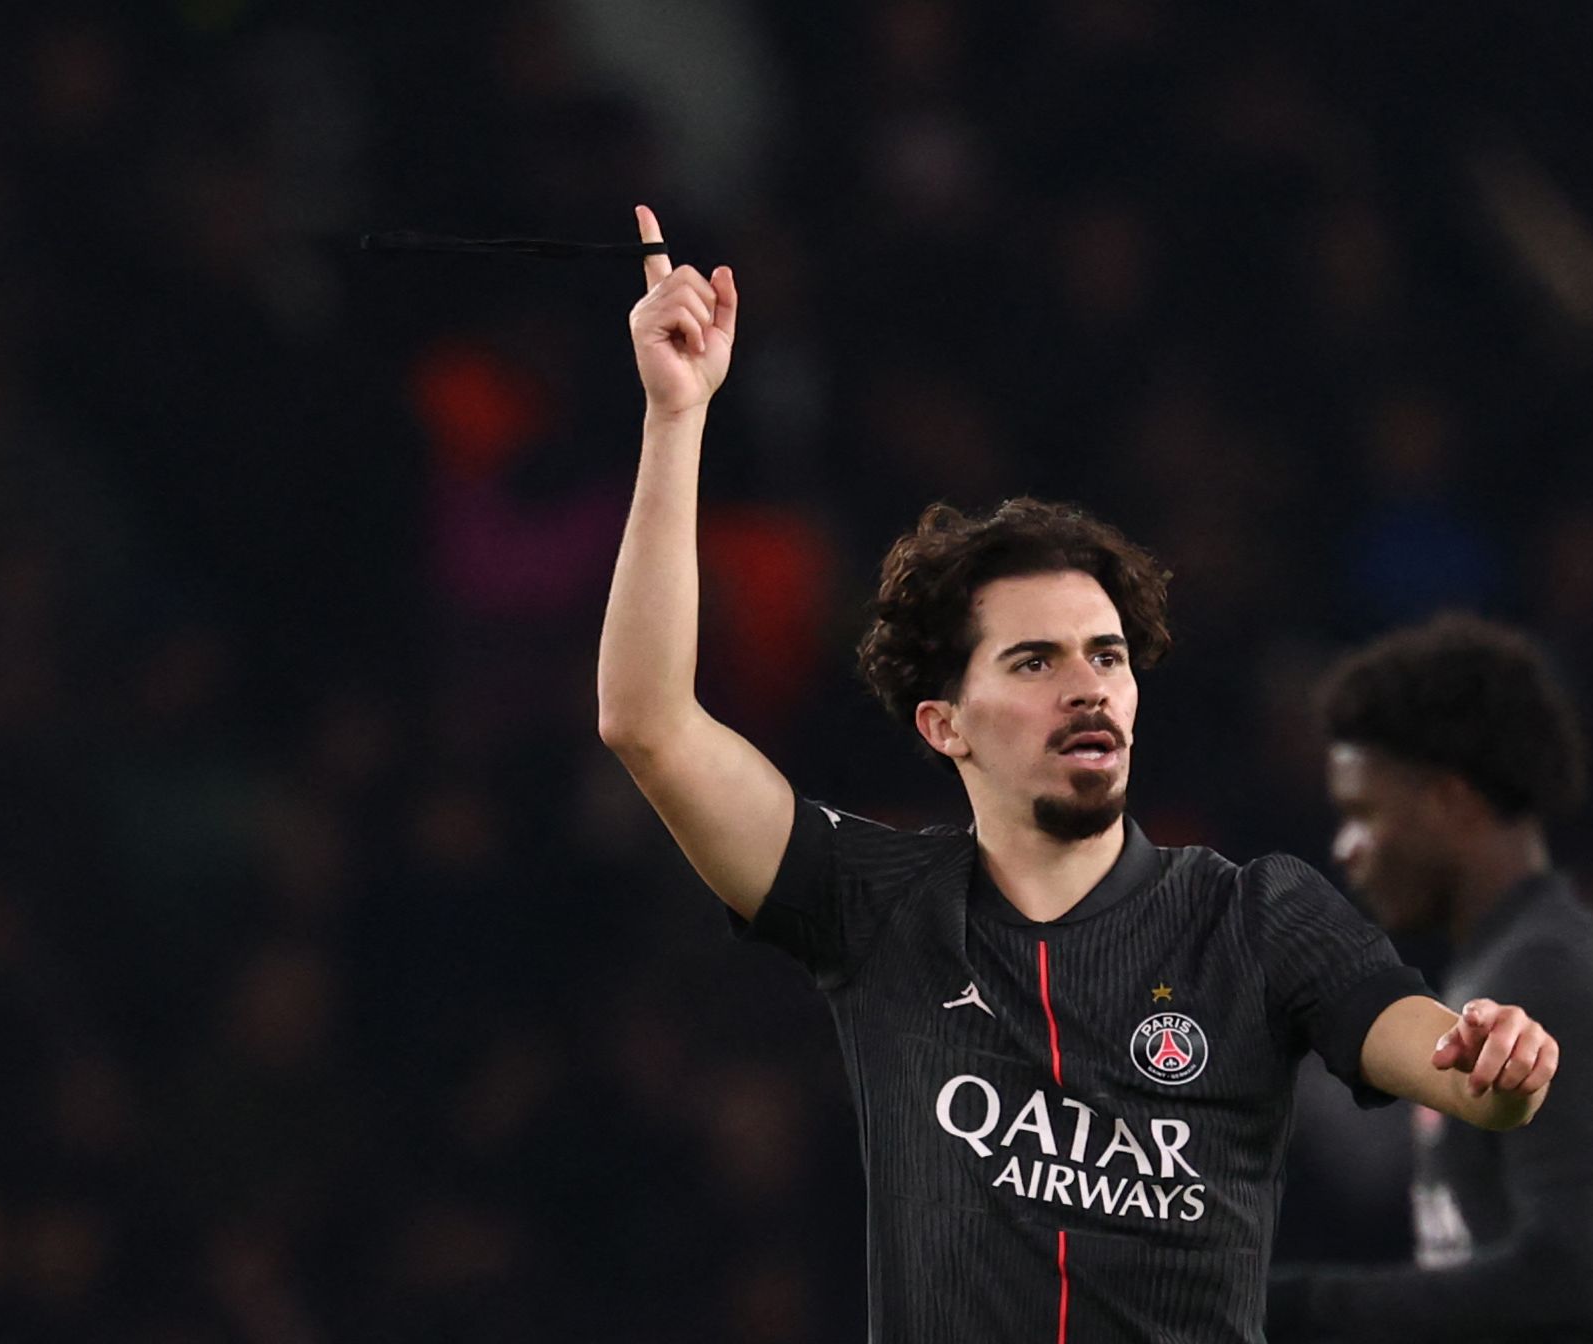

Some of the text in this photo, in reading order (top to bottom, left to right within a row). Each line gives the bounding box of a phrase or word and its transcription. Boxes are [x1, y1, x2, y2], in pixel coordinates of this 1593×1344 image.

[1140, 1016, 1192, 1037] PARIS
[935, 1074, 1201, 1179] QATAR
[992, 1155, 1206, 1222] AIRWAYS
